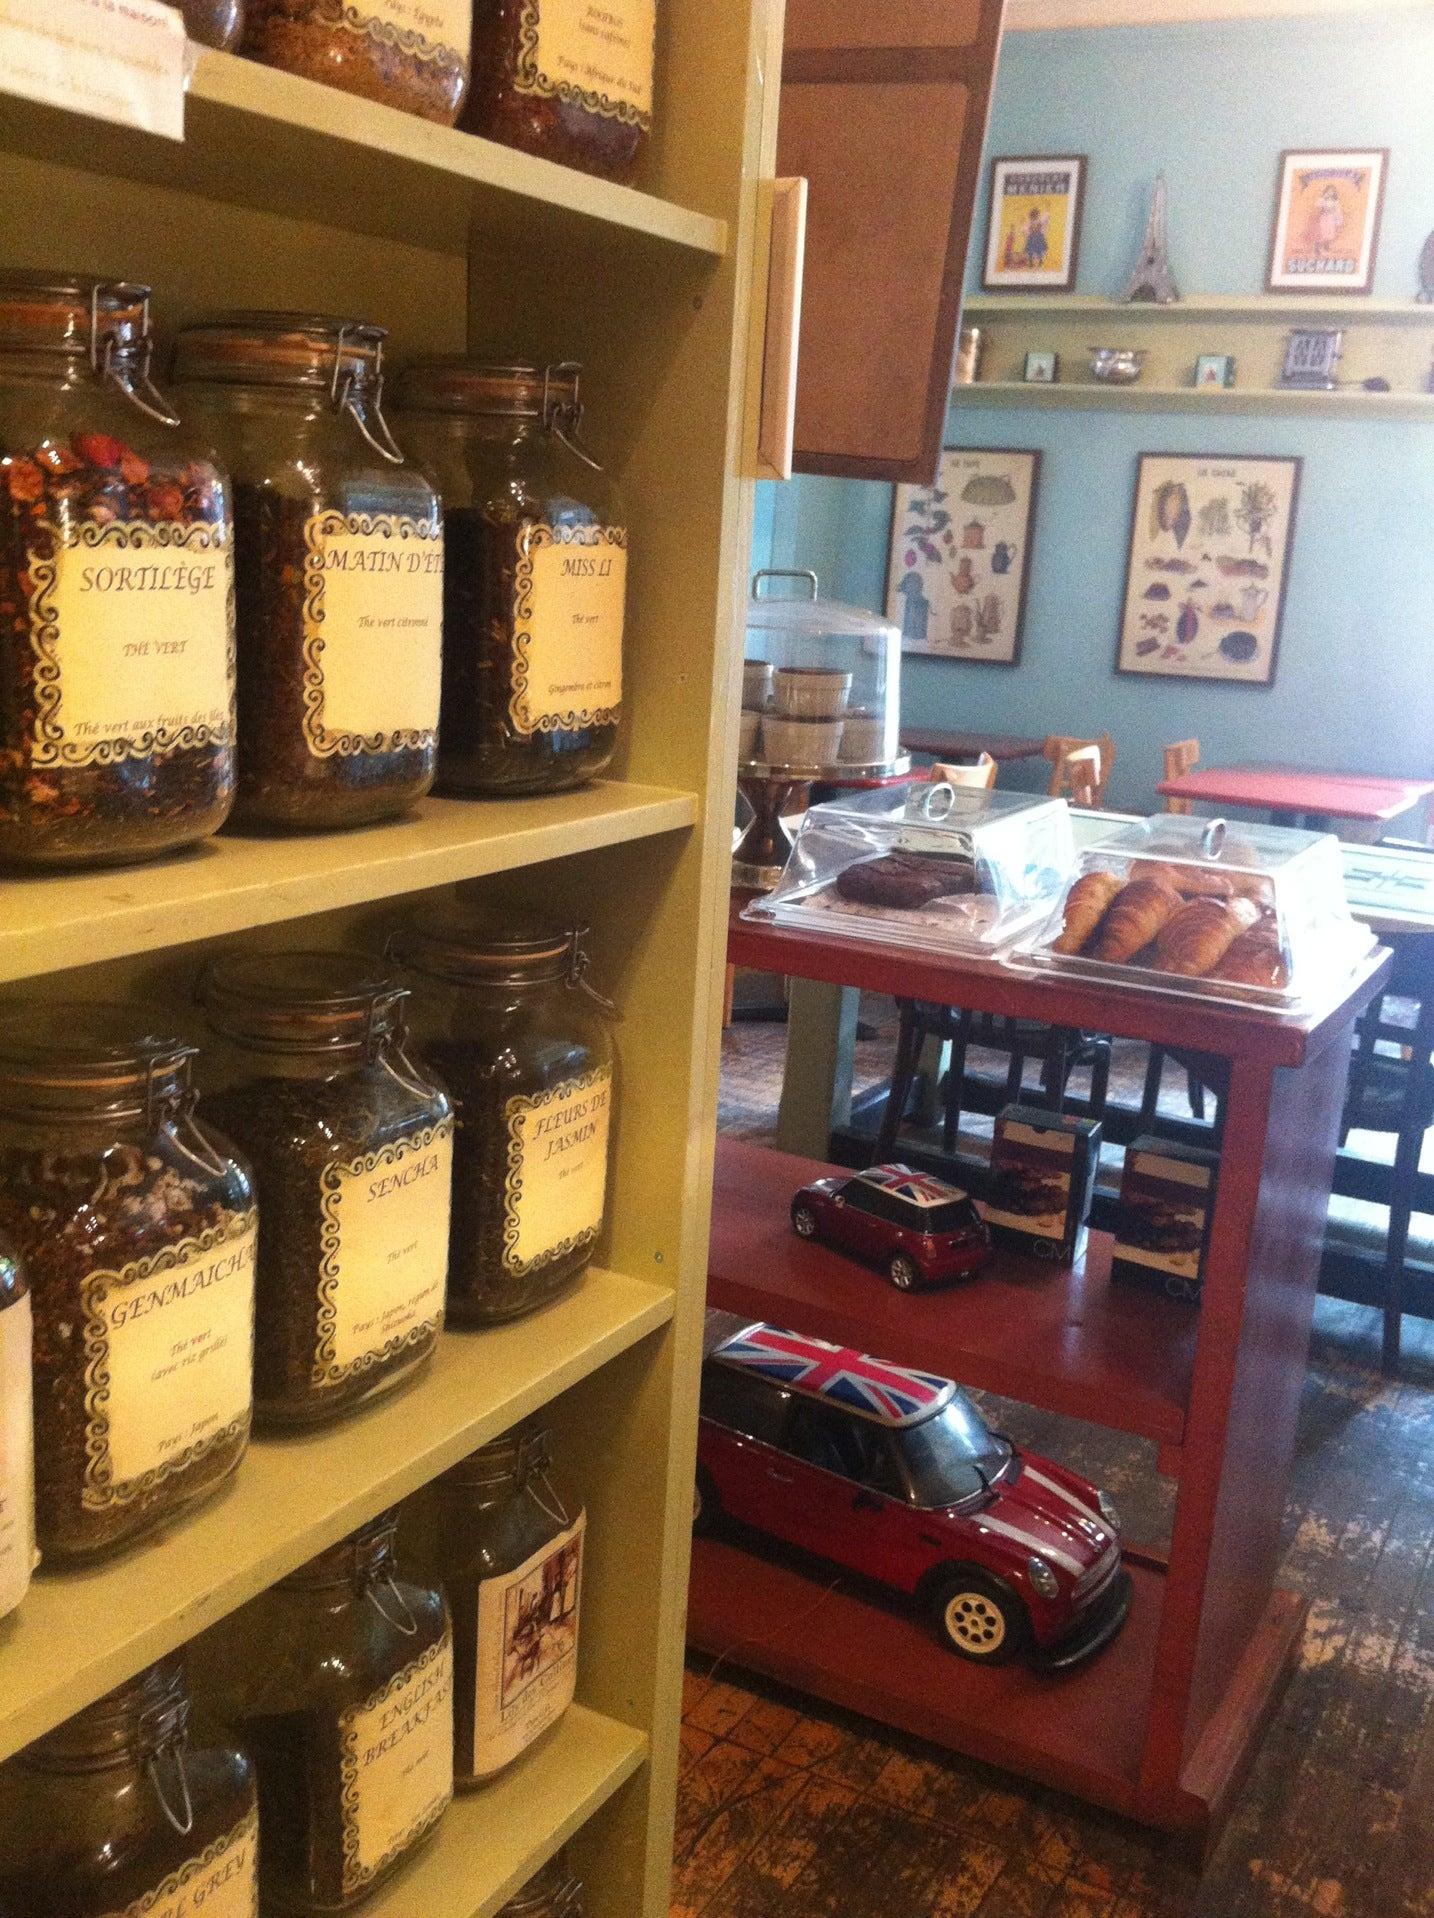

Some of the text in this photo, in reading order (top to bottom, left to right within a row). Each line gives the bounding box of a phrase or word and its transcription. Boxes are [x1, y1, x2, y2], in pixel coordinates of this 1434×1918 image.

[1286, 258, 1356, 275] SUCHARD
[79, 560, 216, 596] SORTILÈGE
[325, 548, 405, 573] MATIN
[560, 558, 613, 577] MISS LI
[154, 639, 189, 656] VERT
[104, 719, 129, 734] vert
[132, 718, 155, 731] aux
[157, 711, 189, 727] fruits
[532, 1089, 609, 1142] FLEURS DE
[543, 1119, 598, 1162] JASMIN
[367, 1152, 440, 1204] SENCHA
[380, 1659, 445, 1732] ENGLISH
[193, 1847, 247, 1909] GREY
